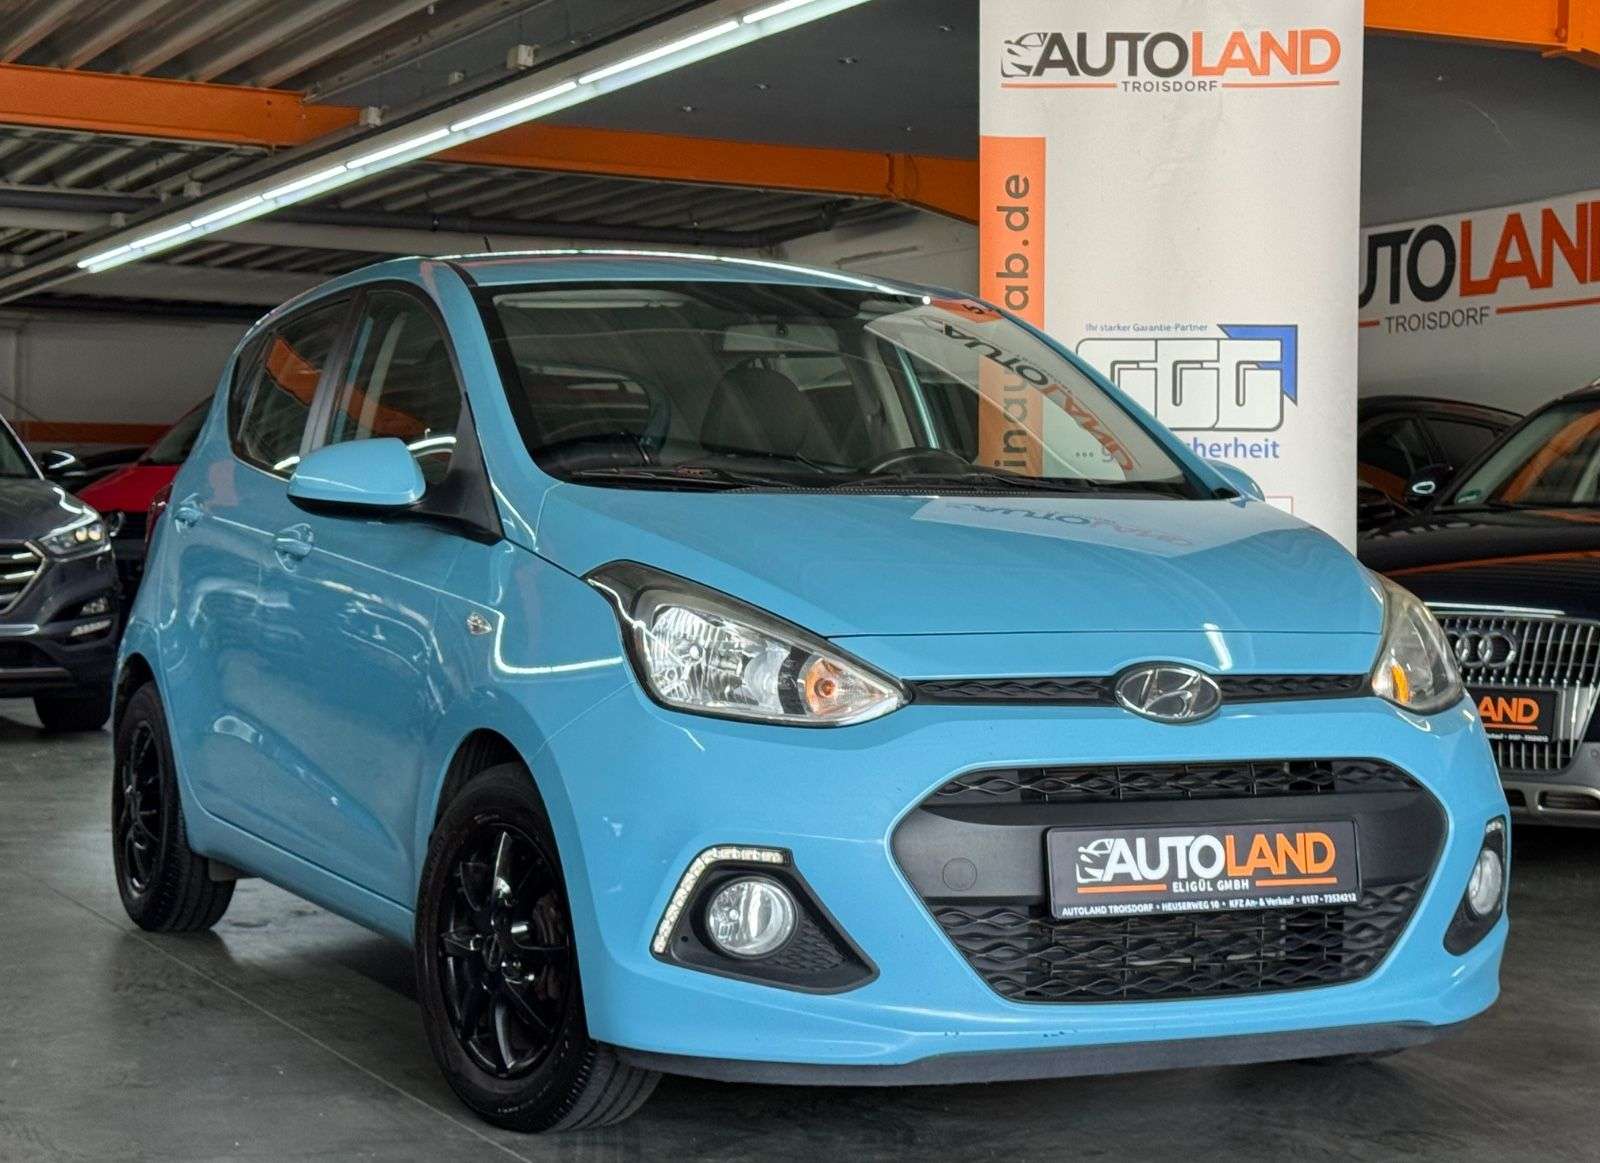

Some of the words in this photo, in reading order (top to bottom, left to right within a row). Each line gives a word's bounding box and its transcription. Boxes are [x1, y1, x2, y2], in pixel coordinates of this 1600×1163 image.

[1031, 28, 1341, 78] AUTOLAND
[1122, 80, 1219, 93] TROISDORF
[1085, 323, 1098, 332] Ihr
[1100, 323, 1131, 332] starker
[1385, 306, 1491, 334] TROISDORF
[1187, 437, 1280, 459] herheit
[1479, 696, 1540, 724] AND
[1102, 831, 1337, 882] AUTOLAND
[1216, 878, 1250, 892] GMBH
[1062, 905, 1107, 916] AUTOLAND
[1108, 903, 1154, 914] TROISDORF
[1161, 900, 1210, 912] HEUSERWEG
[1229, 898, 1244, 908] KFZ
